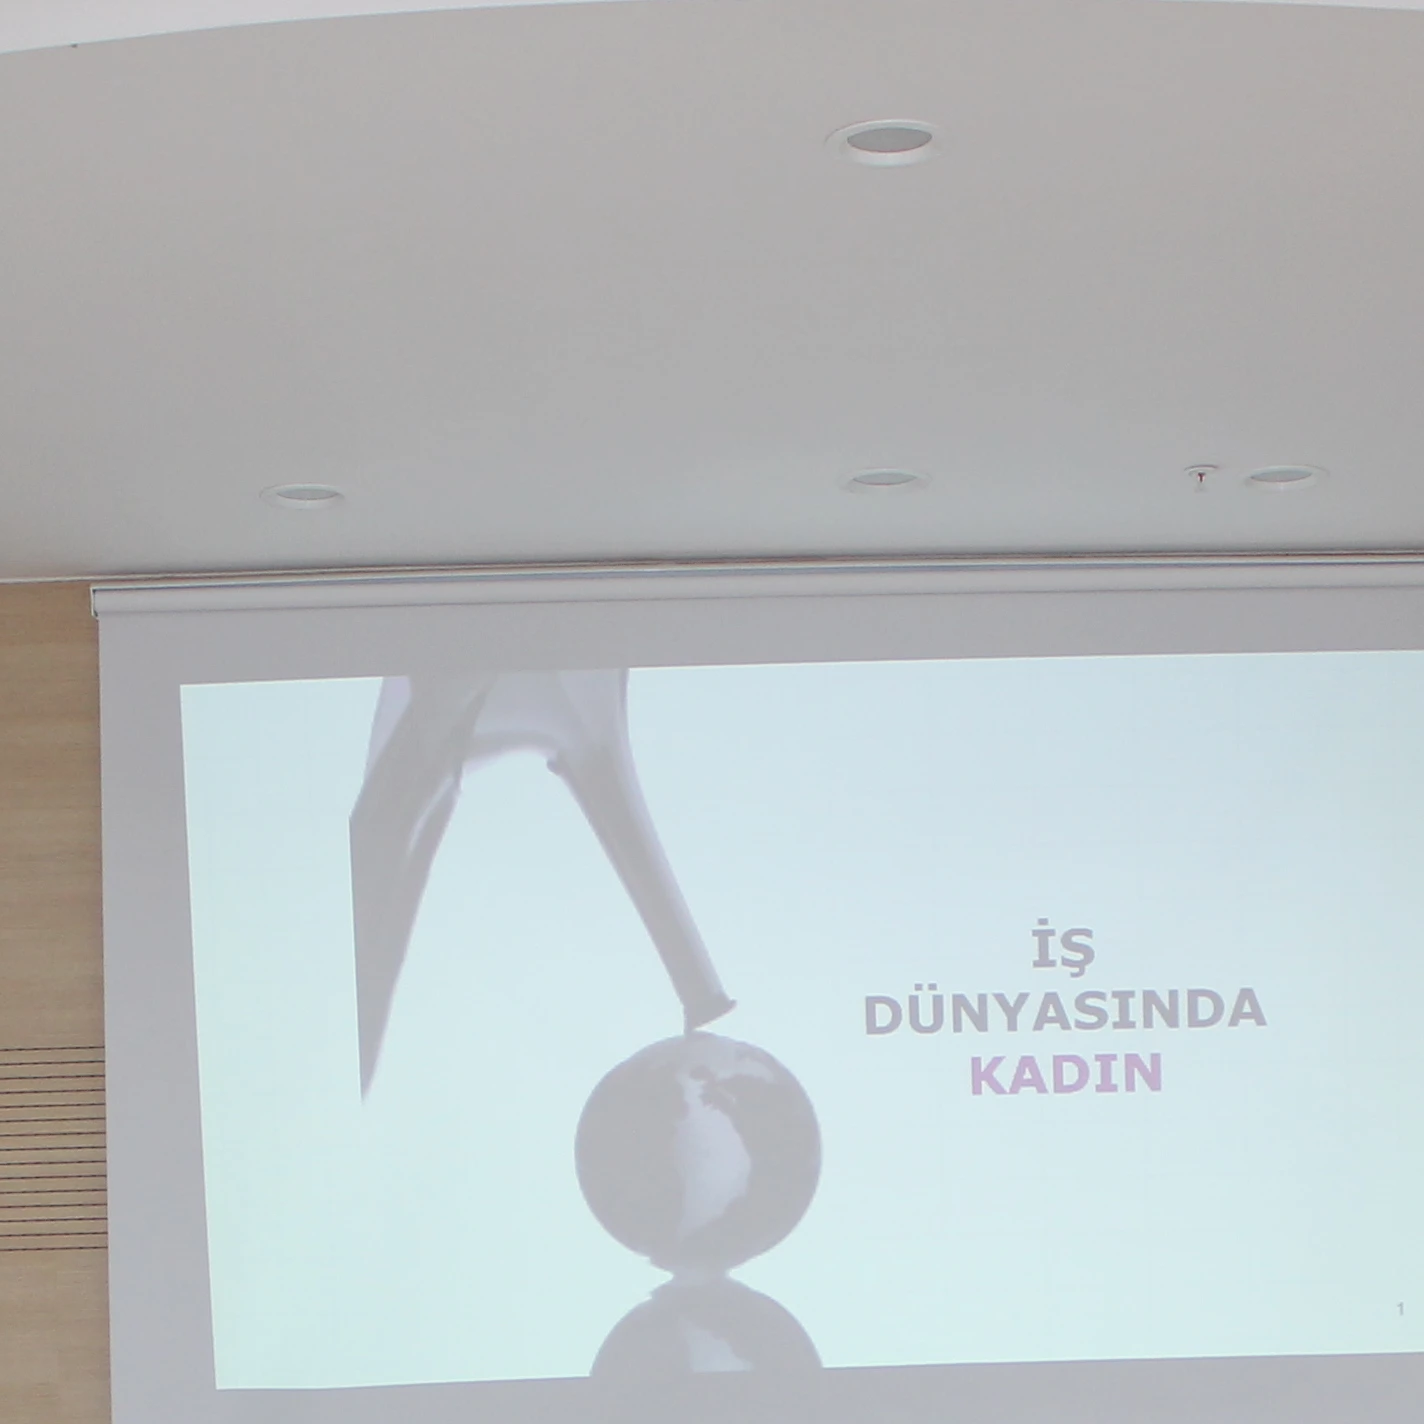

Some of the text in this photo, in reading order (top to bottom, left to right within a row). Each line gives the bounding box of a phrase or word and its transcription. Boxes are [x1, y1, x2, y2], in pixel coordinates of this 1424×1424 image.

[1030, 917, 1096, 979] İŞ
[864, 982, 1268, 1035] DÜNYASINDA
[970, 1052, 1163, 1096] KADIN
[1397, 1301, 1404, 1316] 1
